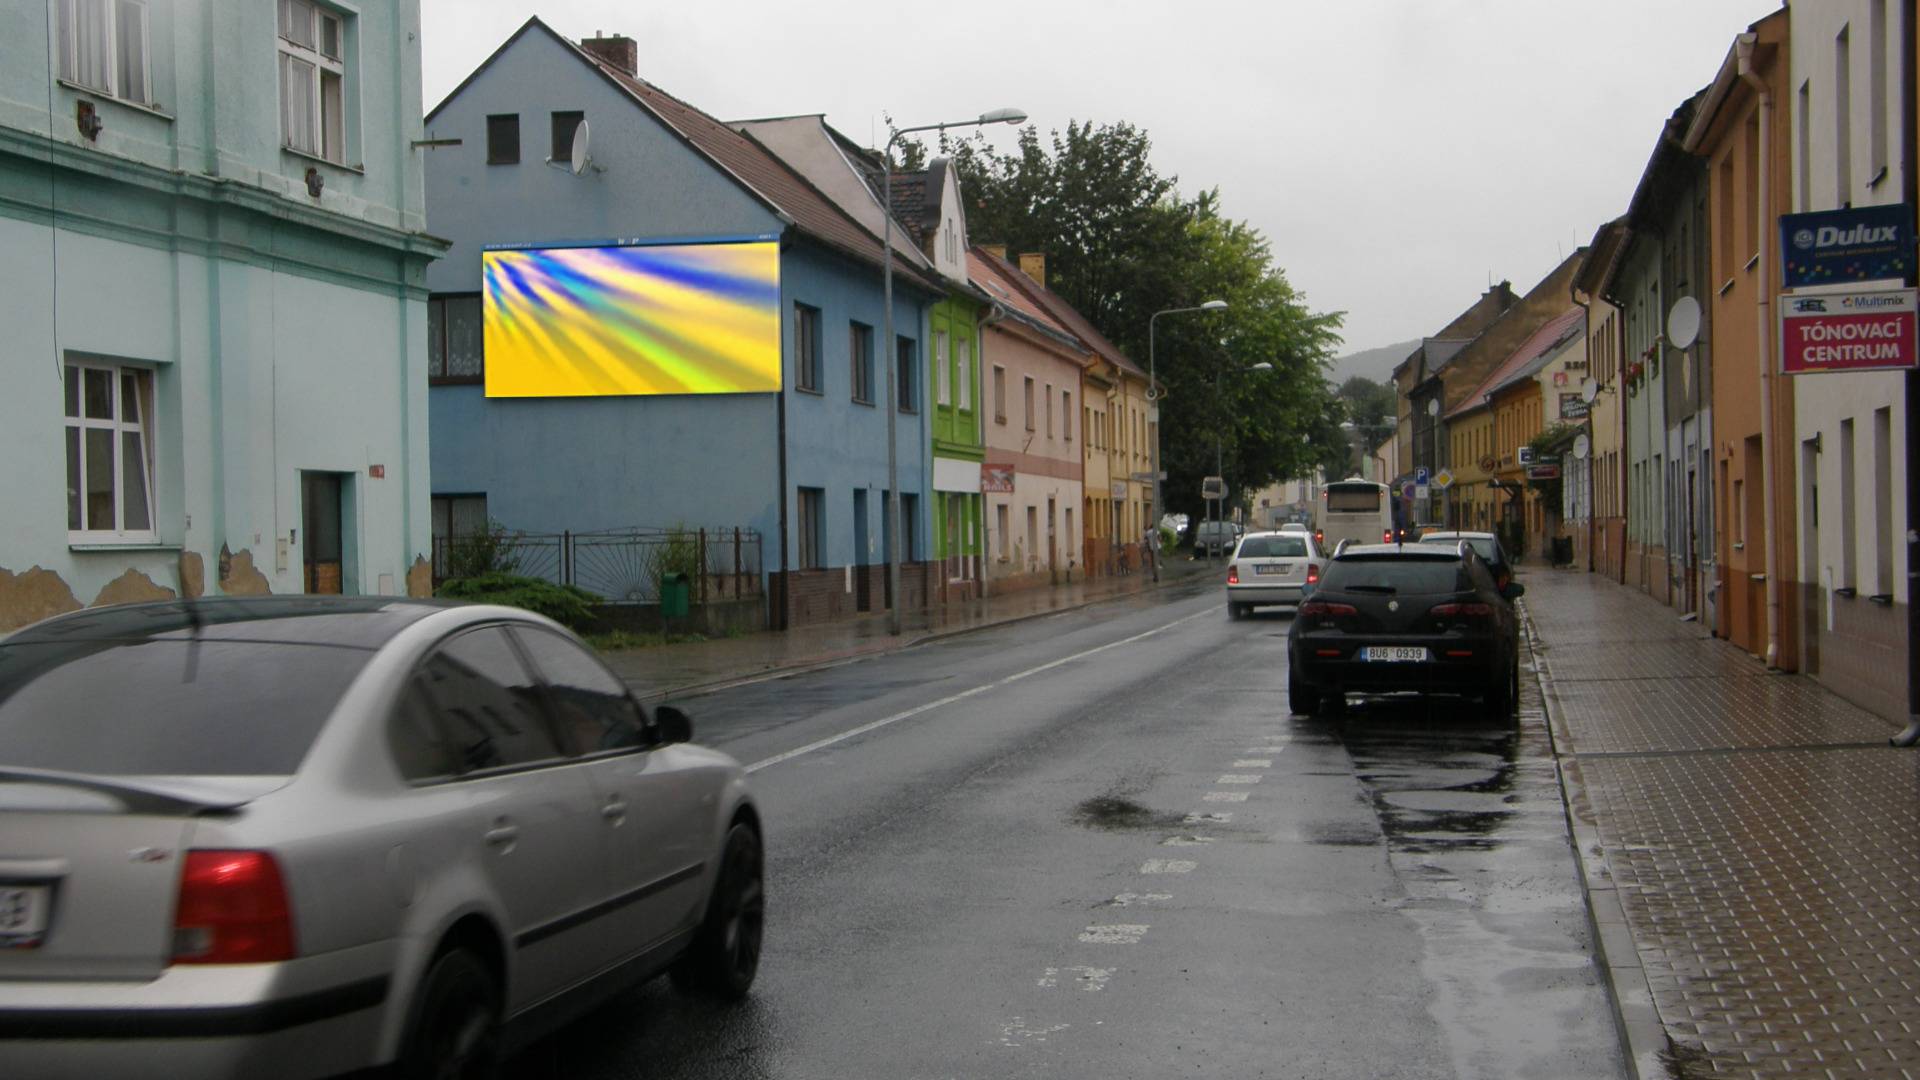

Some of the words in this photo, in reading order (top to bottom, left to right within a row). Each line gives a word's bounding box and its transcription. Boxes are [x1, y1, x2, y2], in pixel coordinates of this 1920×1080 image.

[1815, 223, 1898, 248] Dulux
[1854, 295, 1905, 308] Multimix
[1800, 317, 1902, 342] TÓNOVACÍ
[1803, 343, 1899, 362] CENTRUM
[1369, 648, 1389, 658] 8U6
[1396, 648, 1422, 659] 0939
